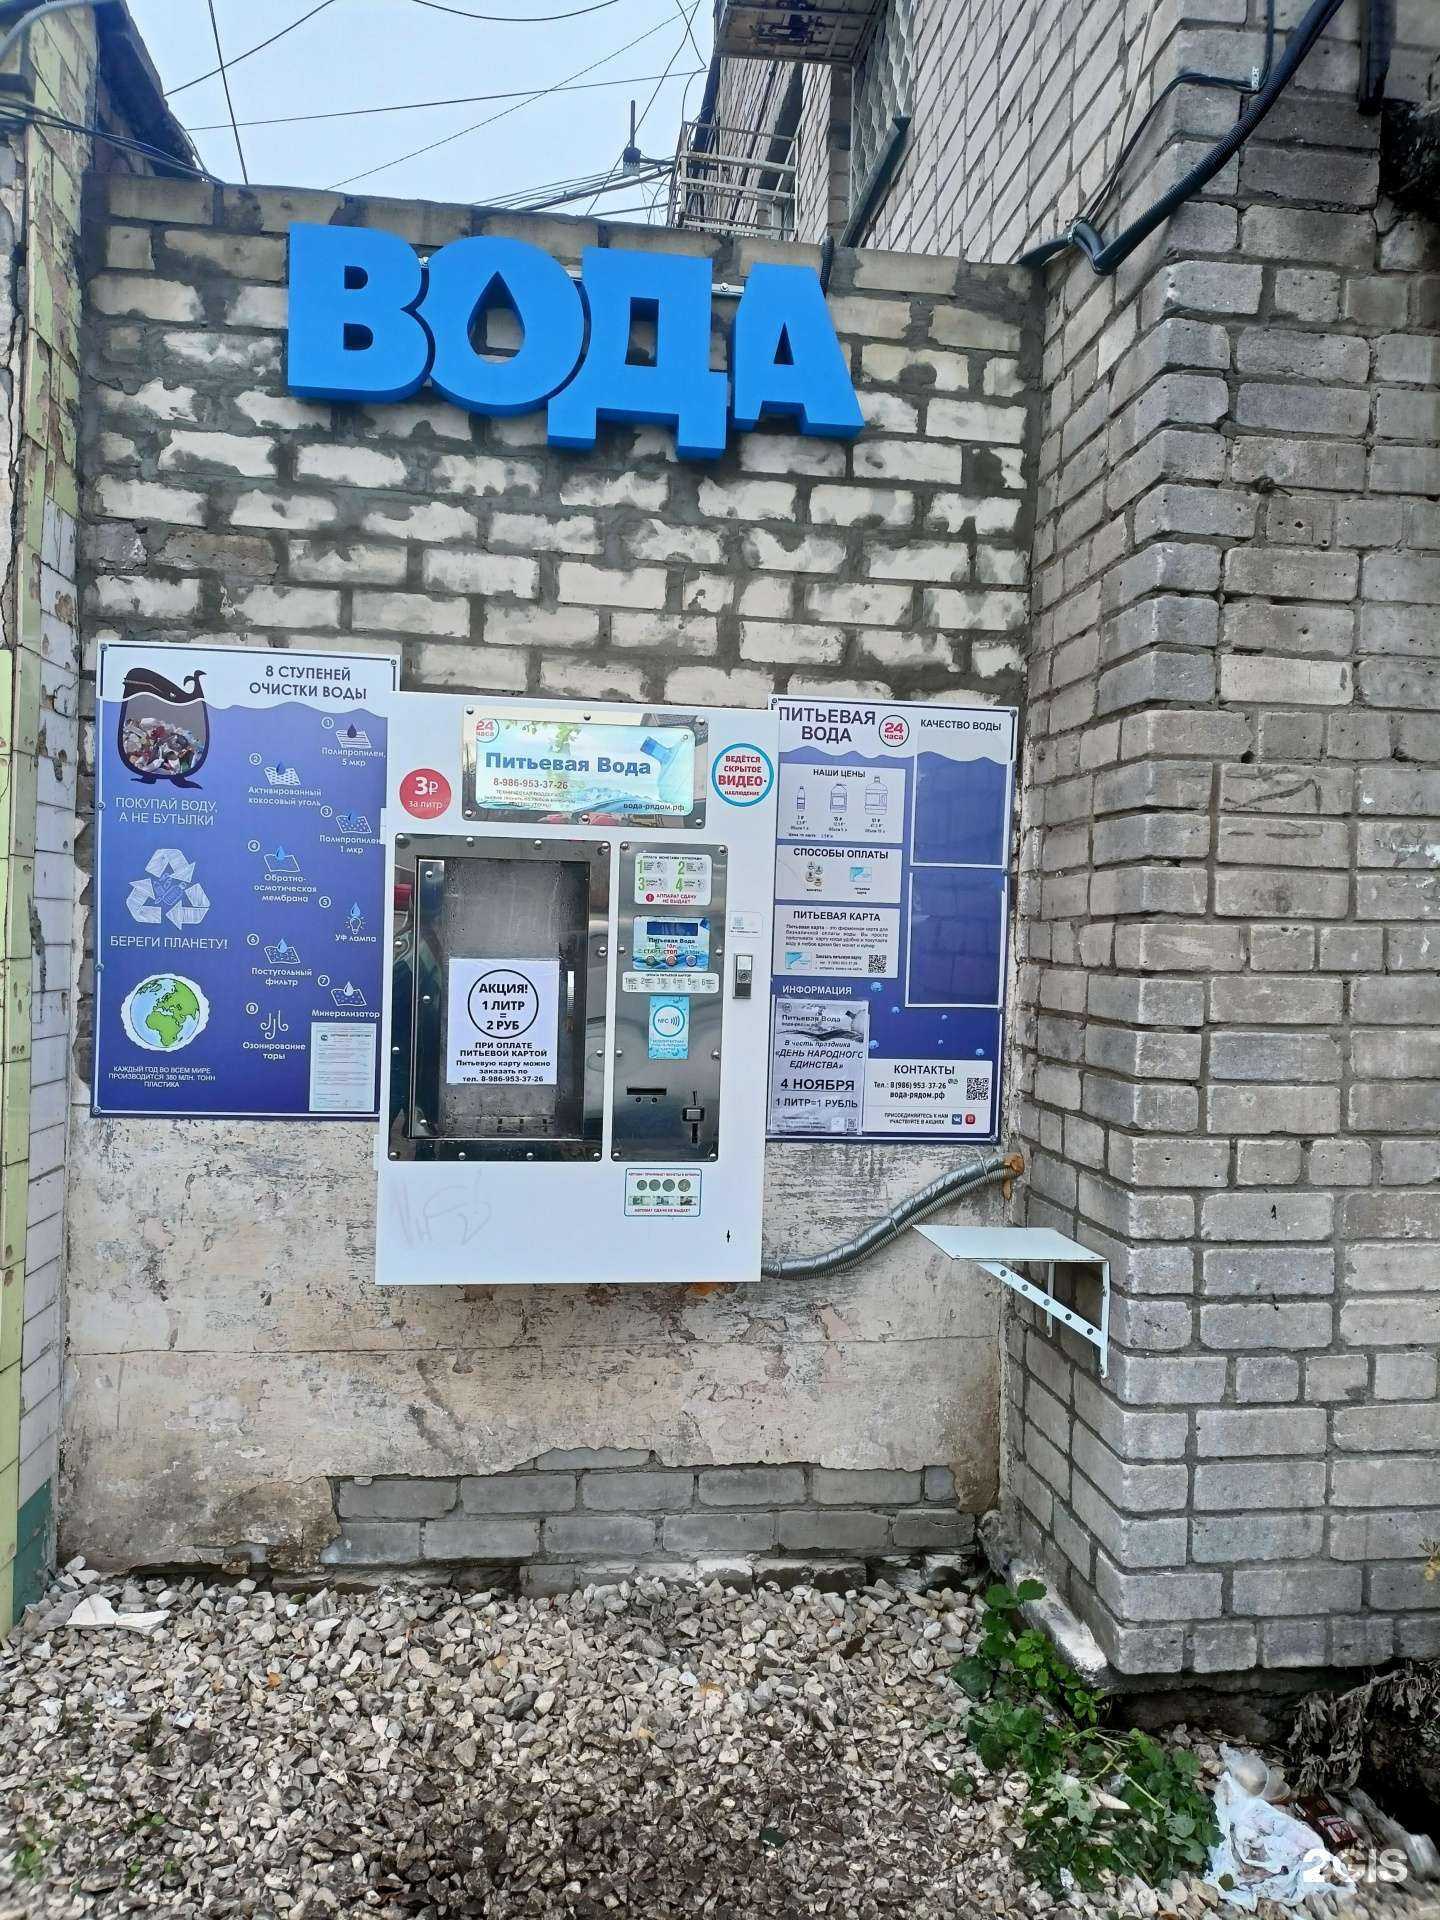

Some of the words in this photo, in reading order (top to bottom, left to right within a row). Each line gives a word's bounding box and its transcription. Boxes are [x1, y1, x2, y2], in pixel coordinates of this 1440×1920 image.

[287, 222, 865, 462] ВОДА
[265, 665, 274, 677] 8
[278, 665, 352, 681] СТУПЕНЕЙ
[249, 682, 318, 697] ОЧИСТКИ
[322, 686, 367, 700] ВОДЫ
[779, 706, 876, 726] ПИТЬЕВАЯ
[476, 720, 494, 731] 24
[884, 722, 904, 734] 24
[920, 719, 970, 730] КАЧЕСТВО
[972, 722, 1002, 732] ВОДЫ
[801, 725, 852, 744] ВОДА
[884, 733, 904, 741] часа
[485, 752, 590, 772] Питьевая
[597, 757, 651, 775] Вода
[725, 755, 761, 764] ВЕДЁТСЯ
[723, 765, 762, 773] СКРЫТОЕ
[813, 769, 839, 778] НАШИ
[840, 770, 866, 779] ЦЕНЫ
[493, 777, 569, 790] 8-986-953-37-26
[248, 786, 322, 798] Активированный
[115, 797, 178, 811] ПОКУПАЙ
[248, 797, 296, 805] кокосовый
[119, 811, 128, 822] А
[131, 812, 149, 823] НЕ
[153, 812, 214, 826] БУТЫЛКИ
[793, 847, 845, 858] СПОСОБЫ
[847, 849, 889, 859] ОПЛАТЫ
[254, 884, 317, 894] осмотическая
[261, 894, 308, 904] мембрана
[793, 911, 847, 920] ПИТЬЕВАЯ
[849, 912, 881, 921] КАРТА
[110, 935, 161, 947] БЕРЕГИ
[164, 937, 228, 950] ПЛАНЕТУ!
[251, 967, 313, 977] Постугольный
[265, 977, 298, 988] фильтр
[479, 984, 528, 995] АКЦИЯ!
[782, 985, 852, 995] ИНФОРМАЦИЯ
[482, 1001, 488, 1010] 1
[491, 1001, 525, 1010] ЛИТР
[311, 1009, 380, 1019] Минерализатор
[487, 1021, 493, 1030] 2
[496, 1021, 520, 1030] РУБ
[242, 1041, 306, 1052] Озонирование
[262, 1051, 286, 1061] торы
[511, 1049, 547, 1057] КАРТОЙ
[789, 1061, 844, 1069] ЕДИНСТВА»
[894, 1065, 955, 1075] КОНТАКТЫ
[780, 1079, 789, 1089] 4
[793, 1079, 855, 1091] НОЯБРЯ
[895, 1082, 912, 1090] (986)
[890, 1092, 946, 1100] вода-рядом.рф
[776, 1098, 780, 1106] 1
[825, 1100, 858, 1108] РУБЛЬ
